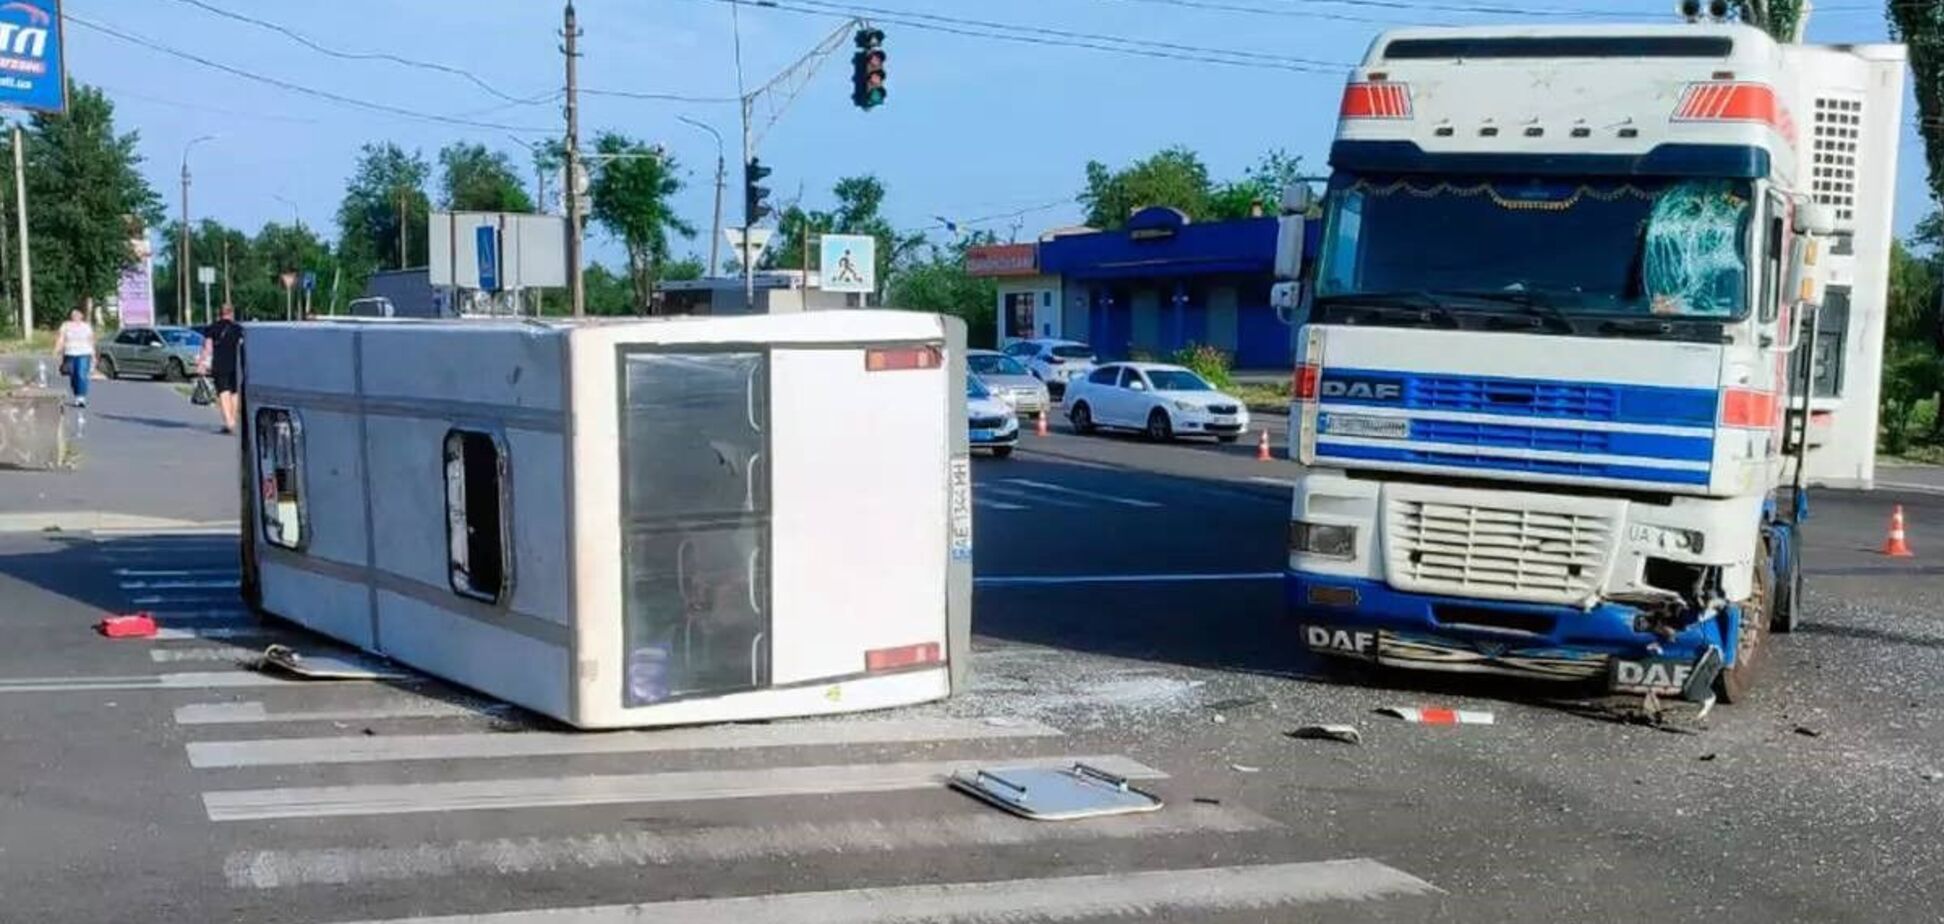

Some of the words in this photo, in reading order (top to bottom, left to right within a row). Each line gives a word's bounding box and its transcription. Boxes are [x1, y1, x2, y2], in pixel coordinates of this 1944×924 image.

[1322, 381, 1401, 398] DAF
[1308, 626, 1374, 652] DAF
[1618, 660, 1692, 687] DAF
